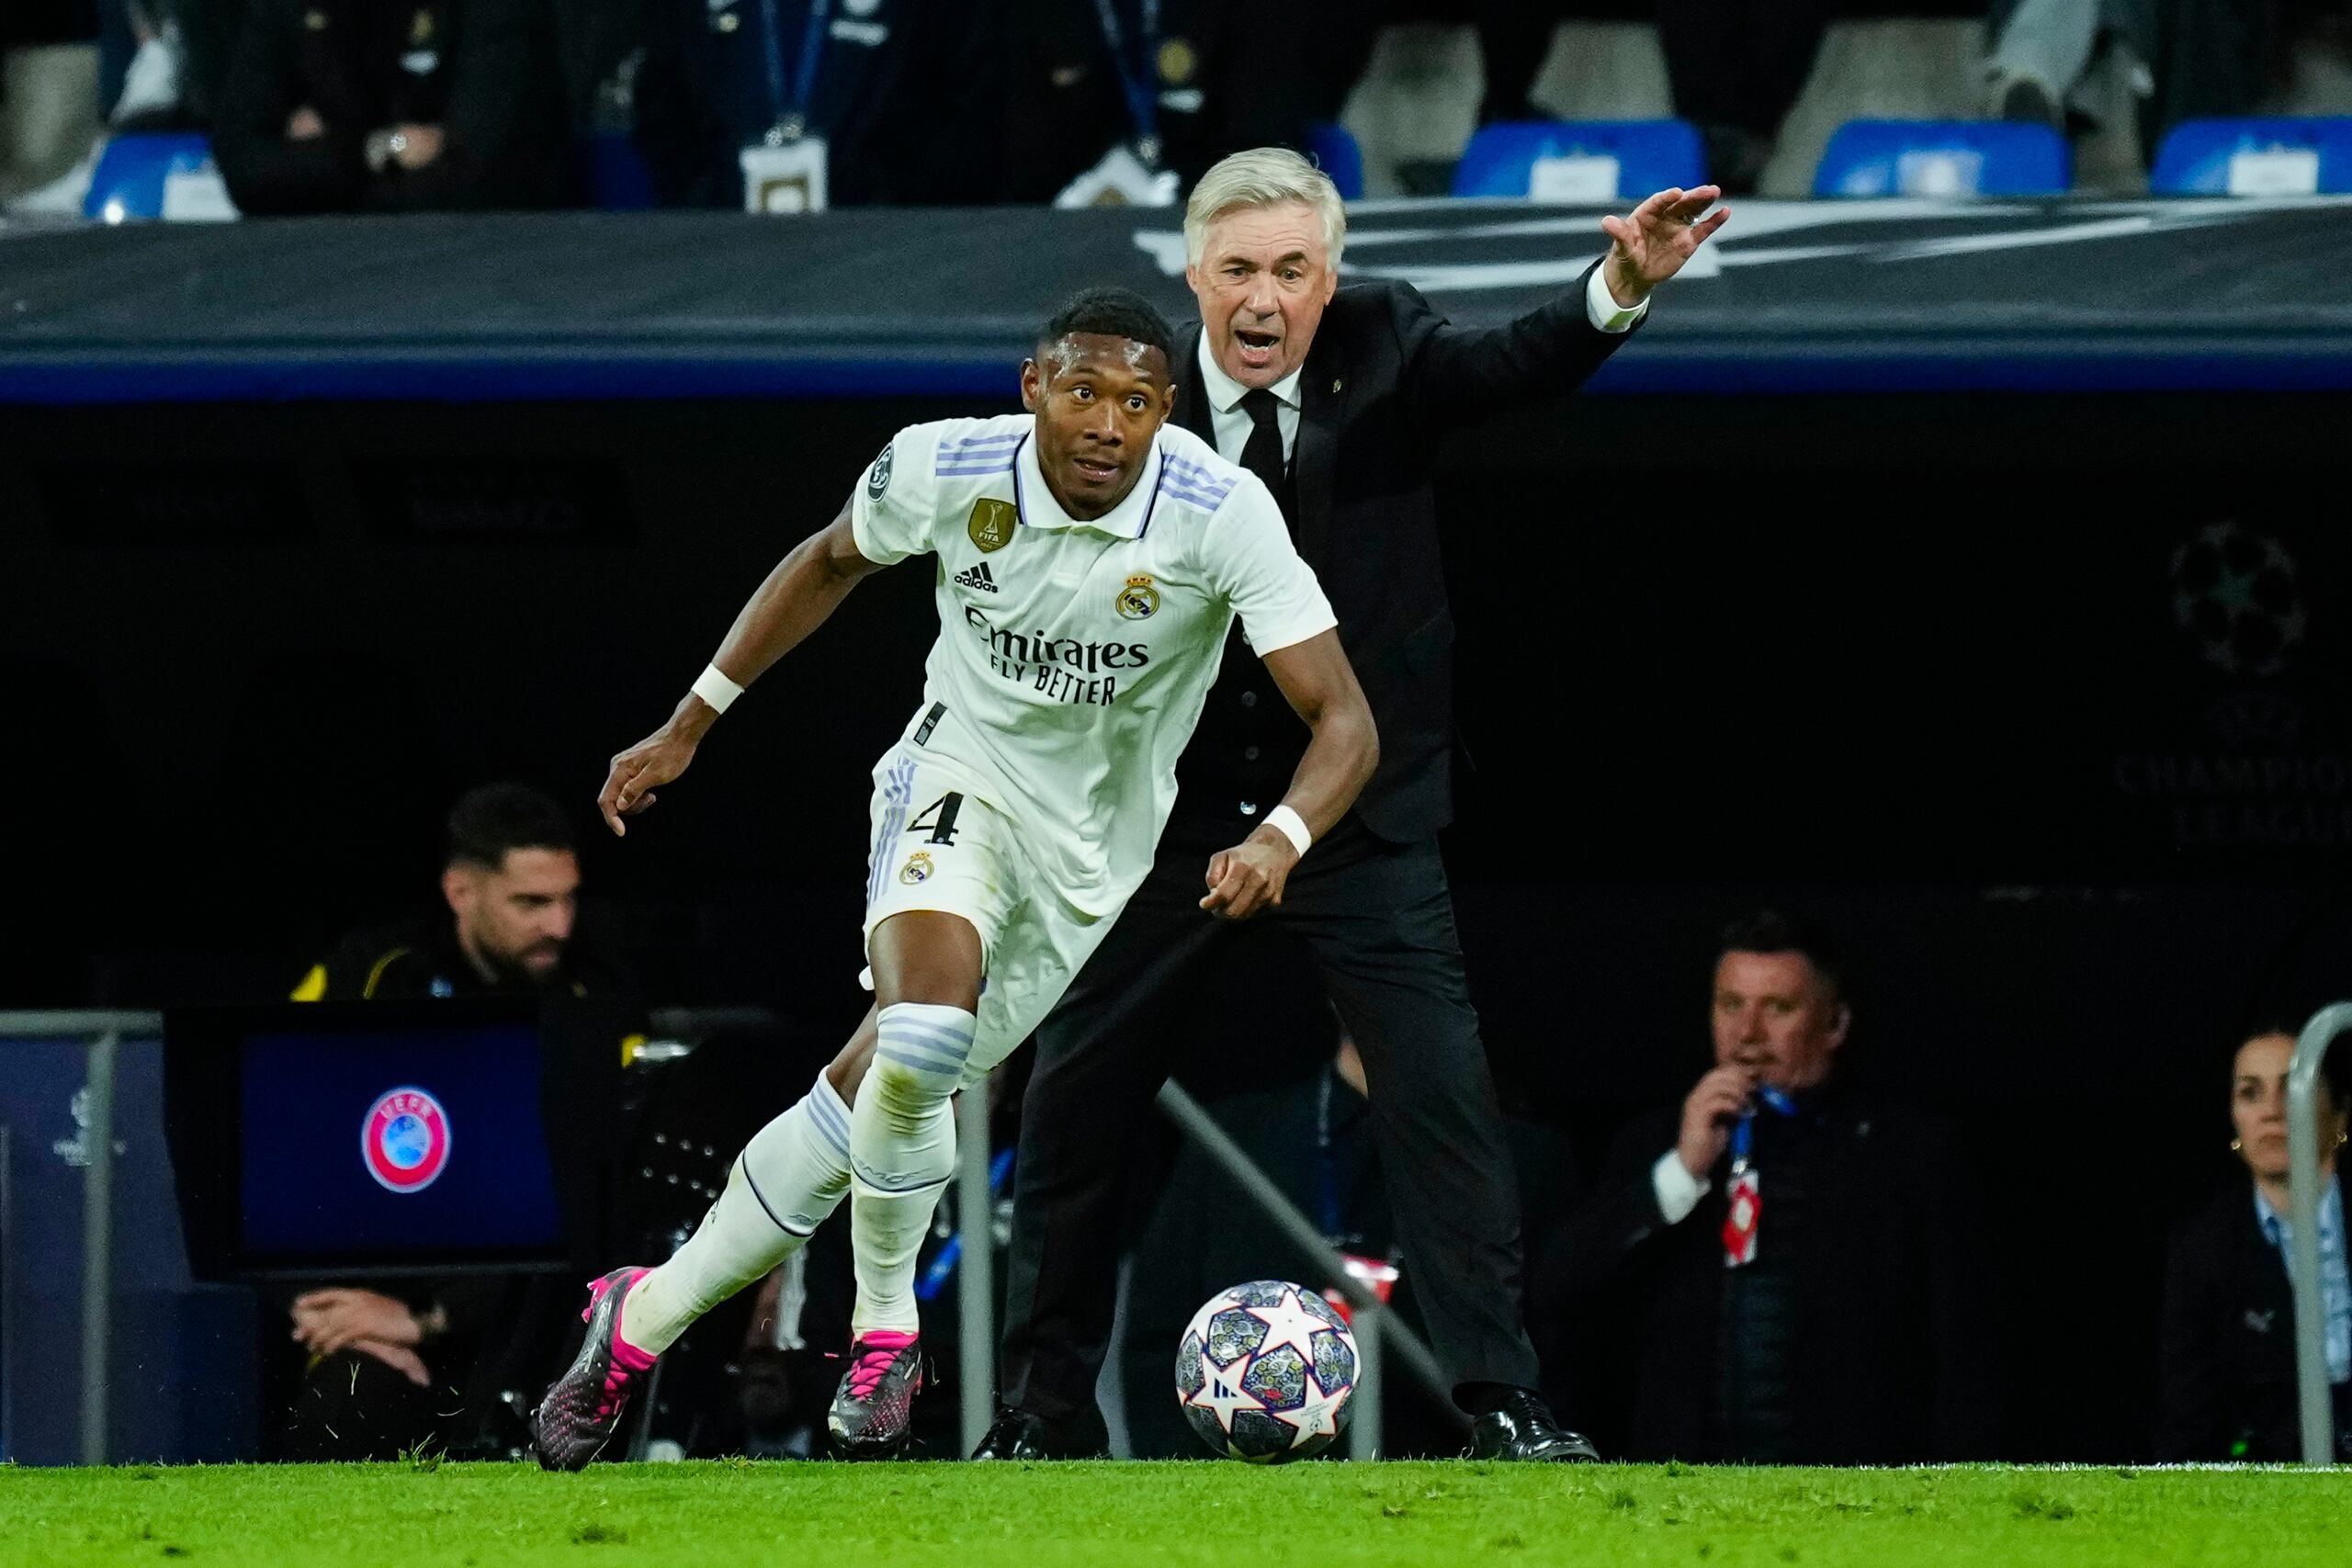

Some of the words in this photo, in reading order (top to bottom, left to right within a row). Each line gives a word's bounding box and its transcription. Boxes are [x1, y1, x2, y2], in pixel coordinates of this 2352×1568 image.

[978, 531, 1000, 542] FIFA
[954, 574, 999, 593] adidas
[965, 604, 1148, 672] Emirates
[990, 653, 1025, 682] FLY
[1034, 665, 1115, 706] BETTER
[2112, 751, 2352, 795] CHAMPIO
[906, 791, 965, 847] 4
